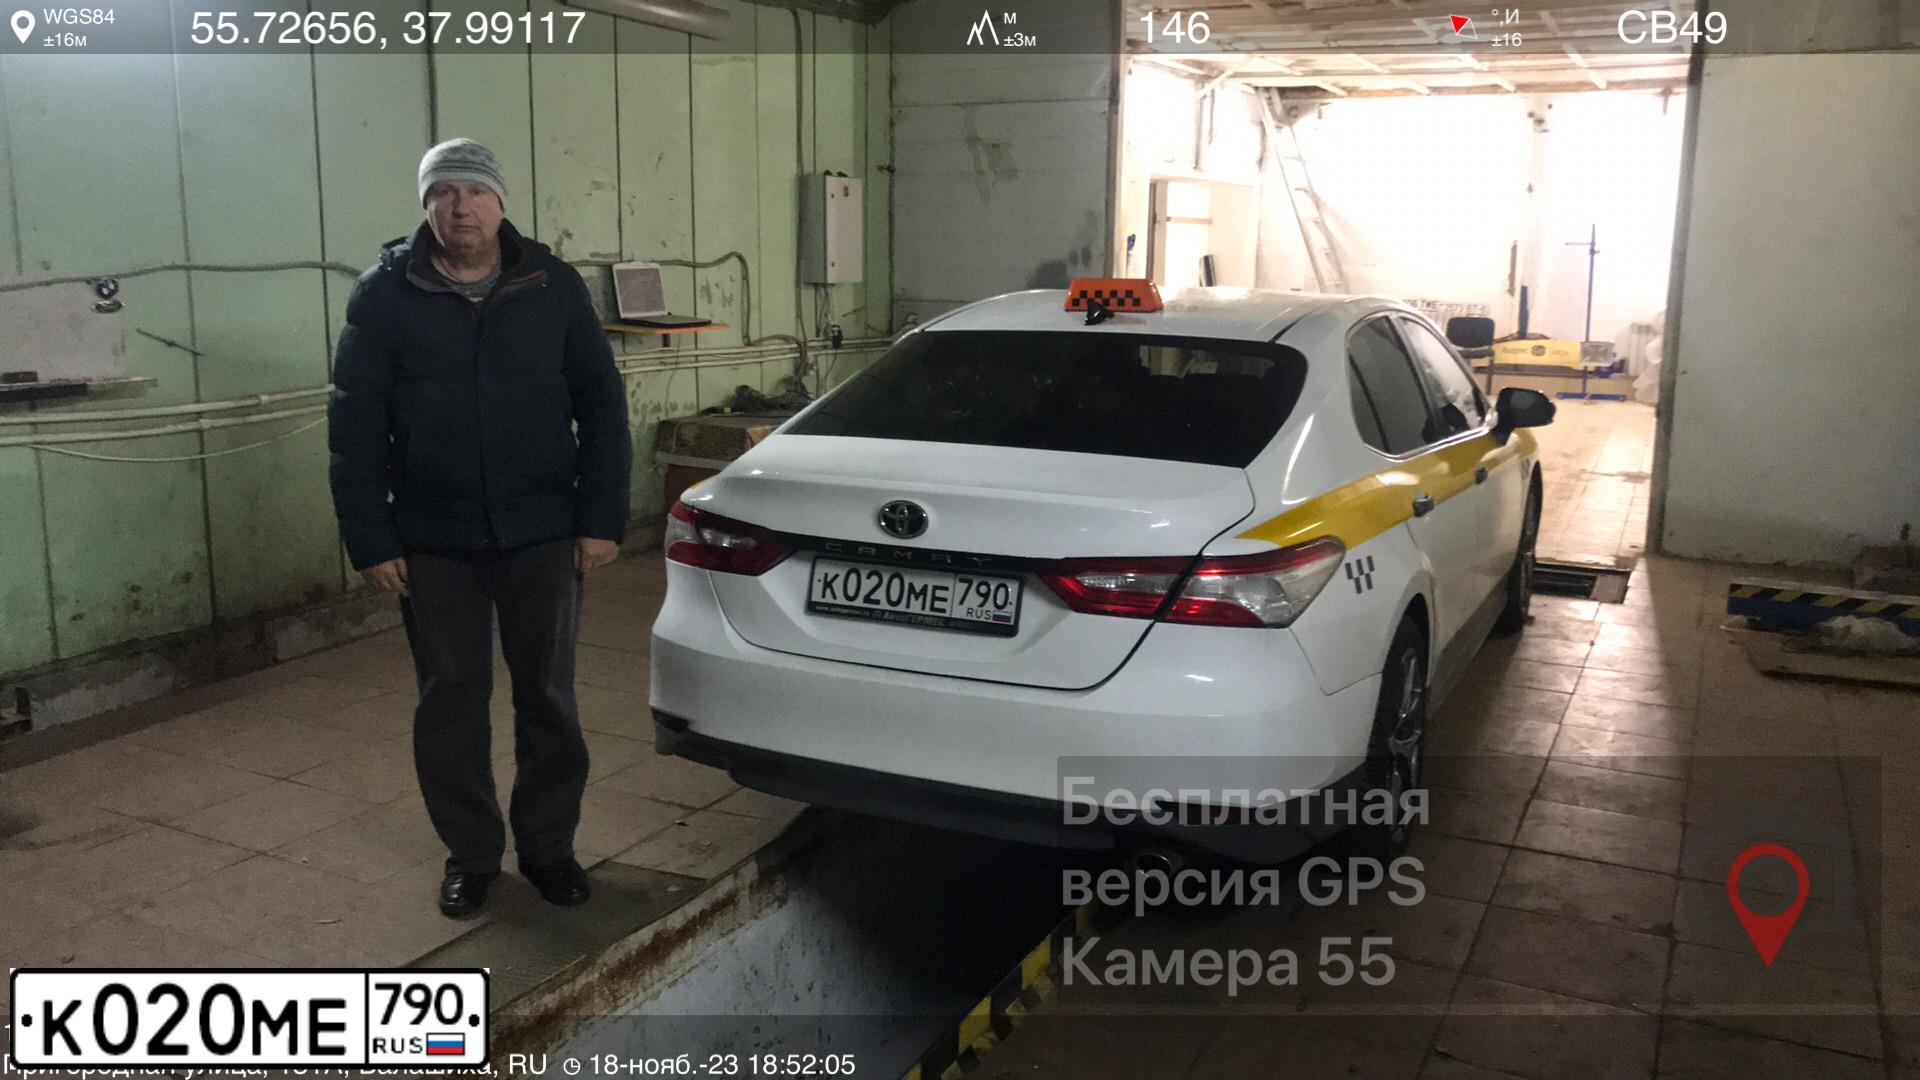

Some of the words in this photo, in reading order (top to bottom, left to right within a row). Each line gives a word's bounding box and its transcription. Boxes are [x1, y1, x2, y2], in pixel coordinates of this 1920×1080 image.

[825, 542, 992, 565] CAMRY
[958, 578, 1010, 610] 790
[966, 607, 991, 620] RUS
